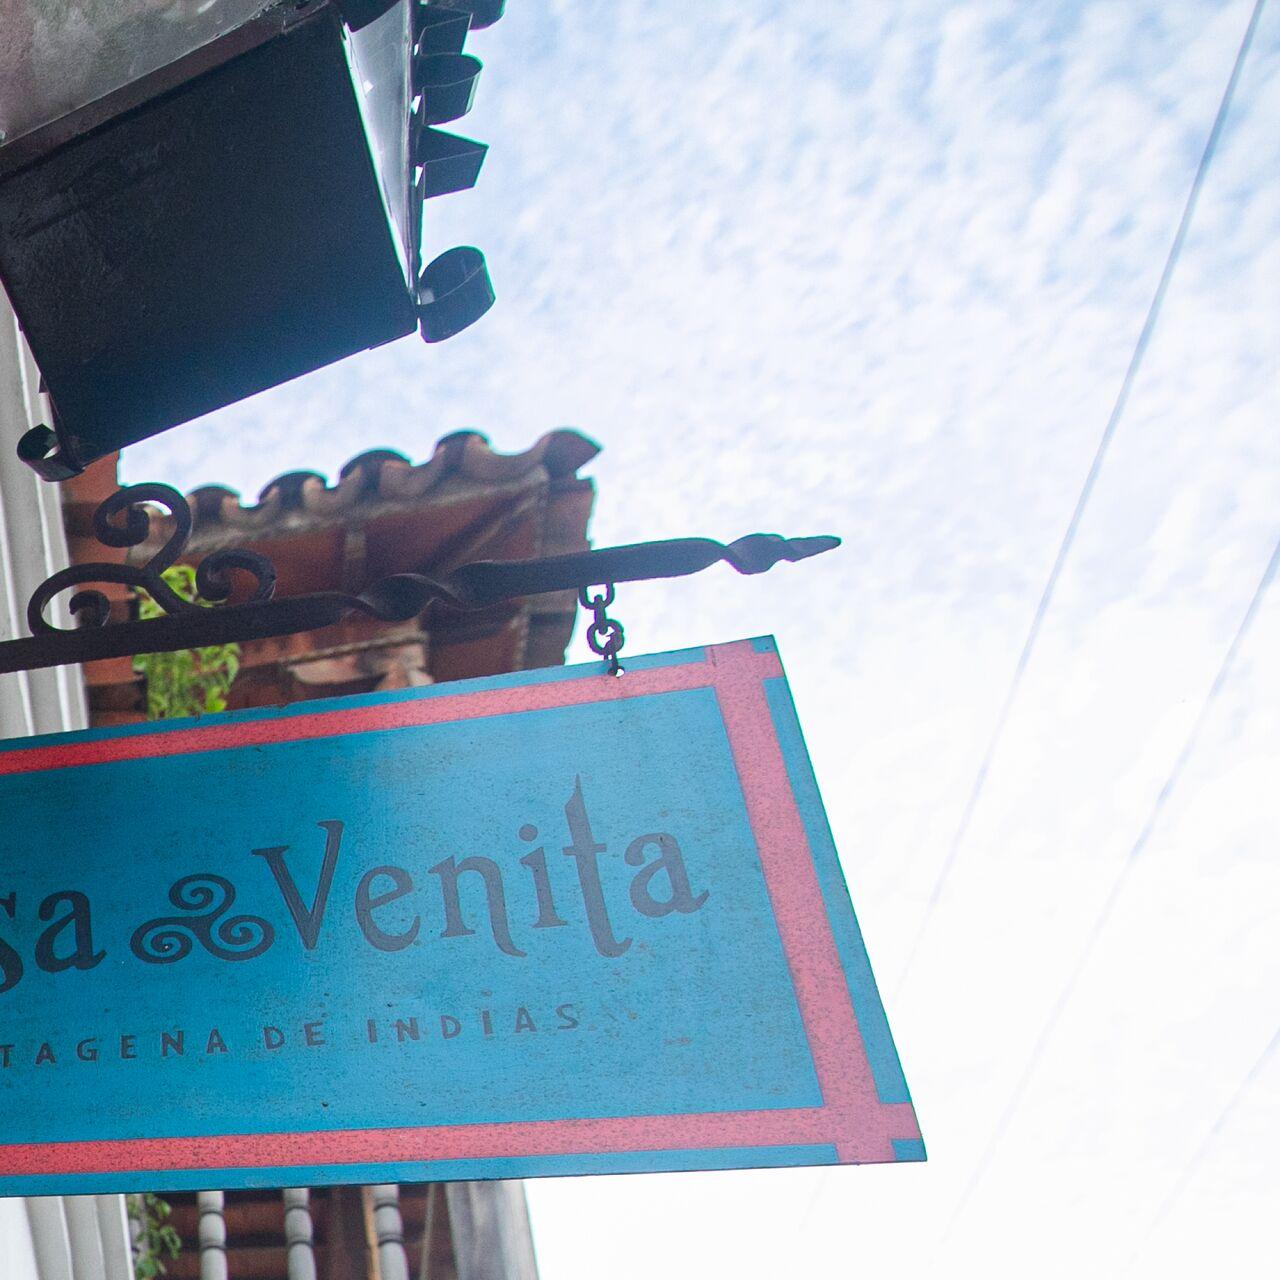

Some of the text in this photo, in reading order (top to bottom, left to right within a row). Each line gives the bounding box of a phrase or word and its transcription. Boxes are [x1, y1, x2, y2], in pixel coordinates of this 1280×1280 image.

[250, 773, 711, 958] Venita
[262, 1020, 326, 1050] DE
[365, 1002, 580, 1044] INDIAS
